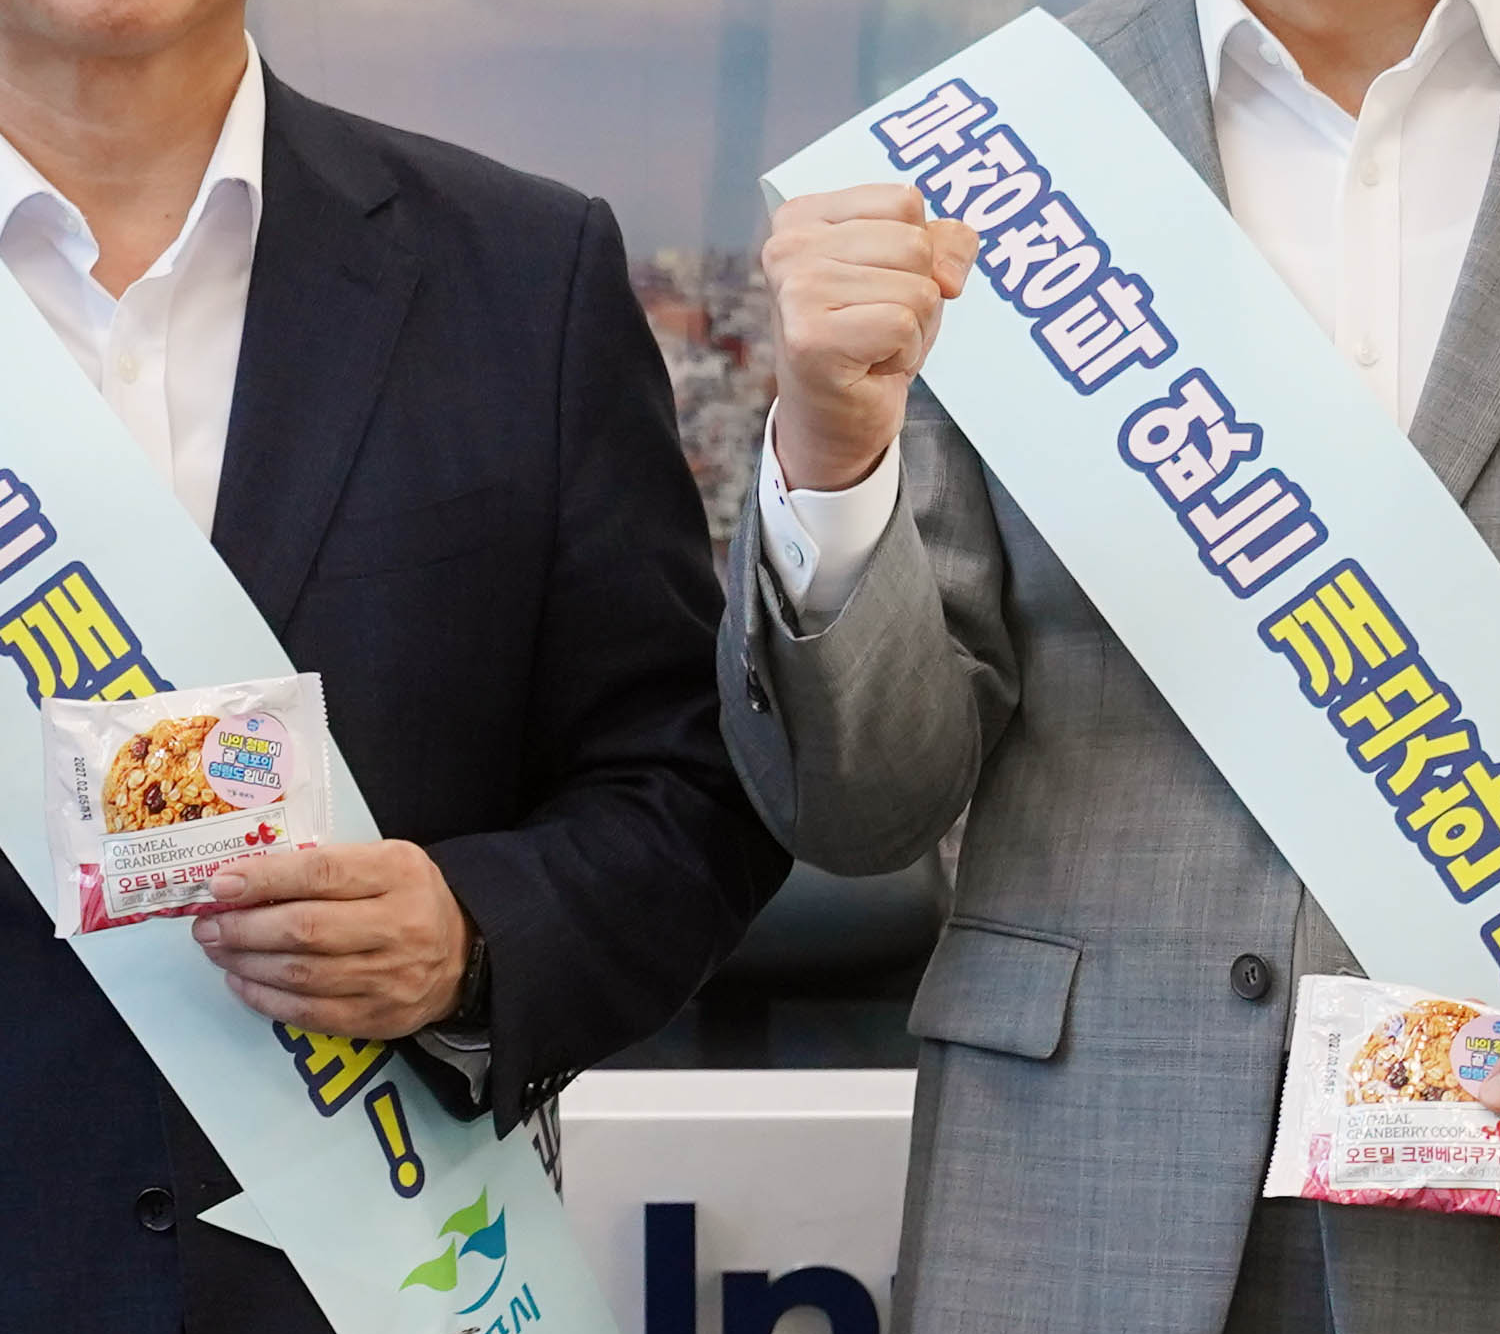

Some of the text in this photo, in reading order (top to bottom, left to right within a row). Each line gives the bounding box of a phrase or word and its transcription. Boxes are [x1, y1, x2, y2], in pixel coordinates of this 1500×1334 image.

[870, 77, 1178, 395] 부정청탁
[1117, 368, 1329, 599] 없는
[219, 731, 243, 749] 나의
[113, 837, 177, 857] OATMEAL
[115, 837, 245, 870] CRANBERRY COOKIE
[119, 873, 168, 895] 오트밀
[1345, 1147, 1394, 1165] 오트밀
